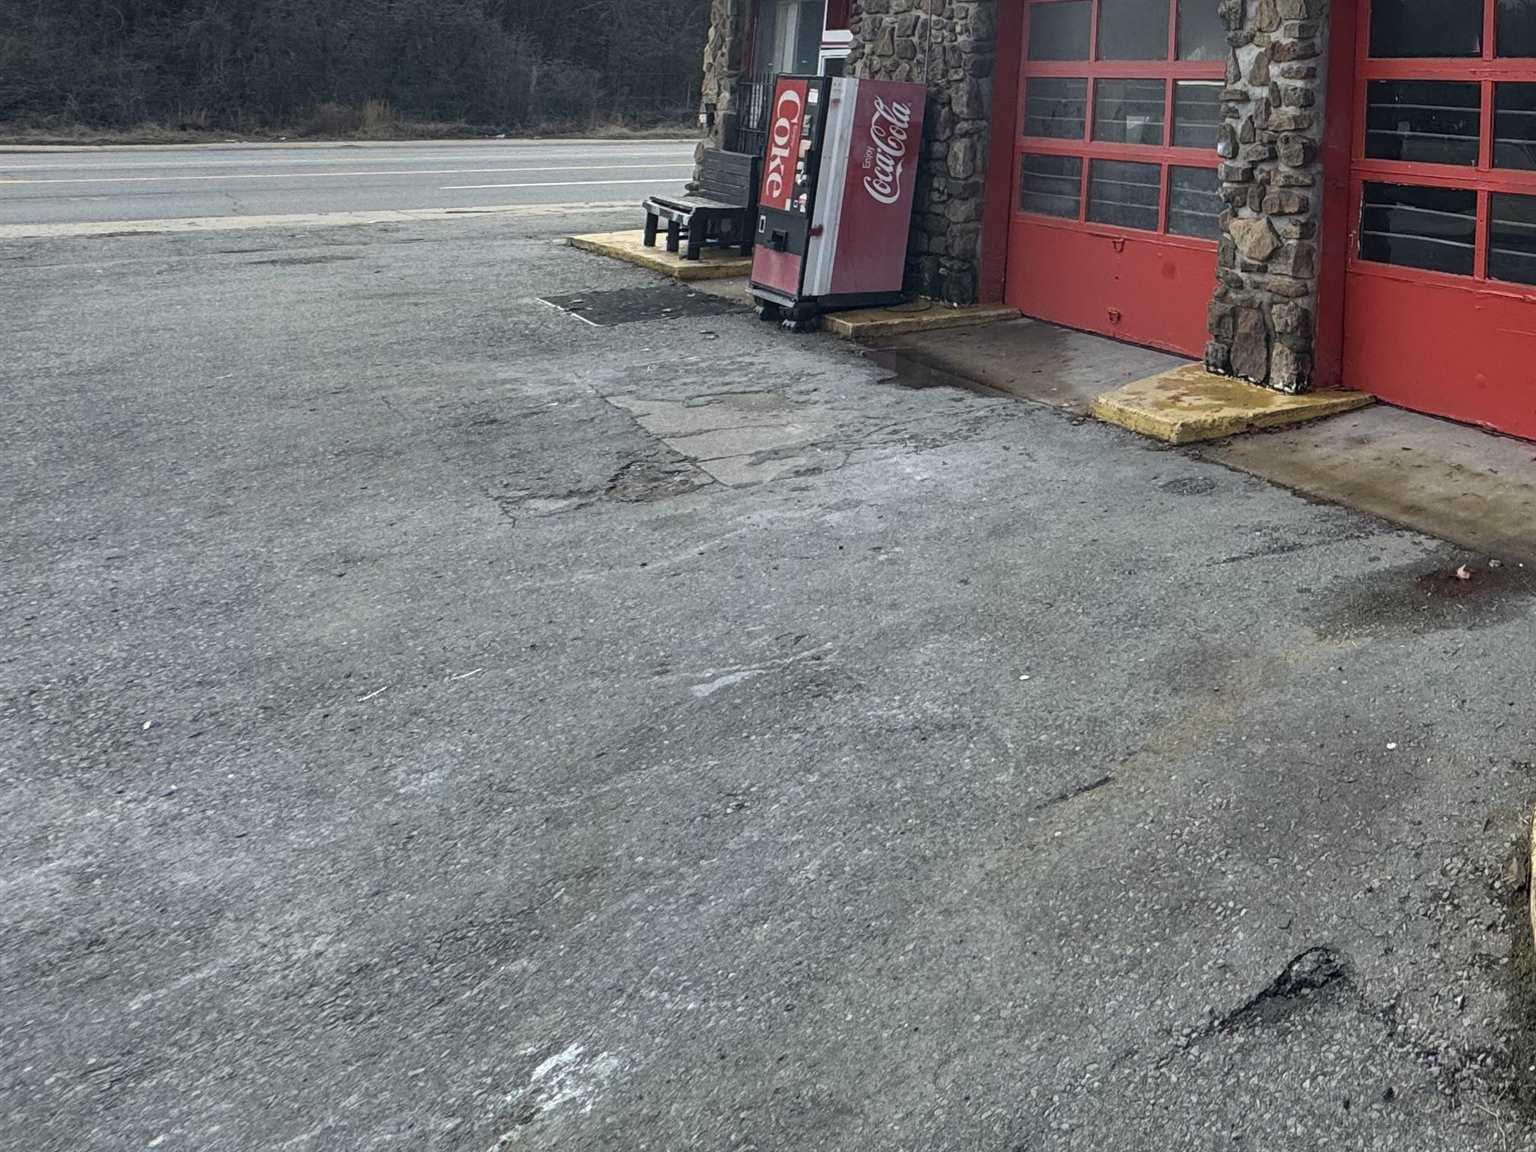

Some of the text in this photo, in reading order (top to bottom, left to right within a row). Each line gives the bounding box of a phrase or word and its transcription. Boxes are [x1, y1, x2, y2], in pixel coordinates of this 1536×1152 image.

[765, 89, 801, 199] Coke
[862, 146, 876, 169] Enjoy
[863, 94, 912, 204] Coca-Cola
